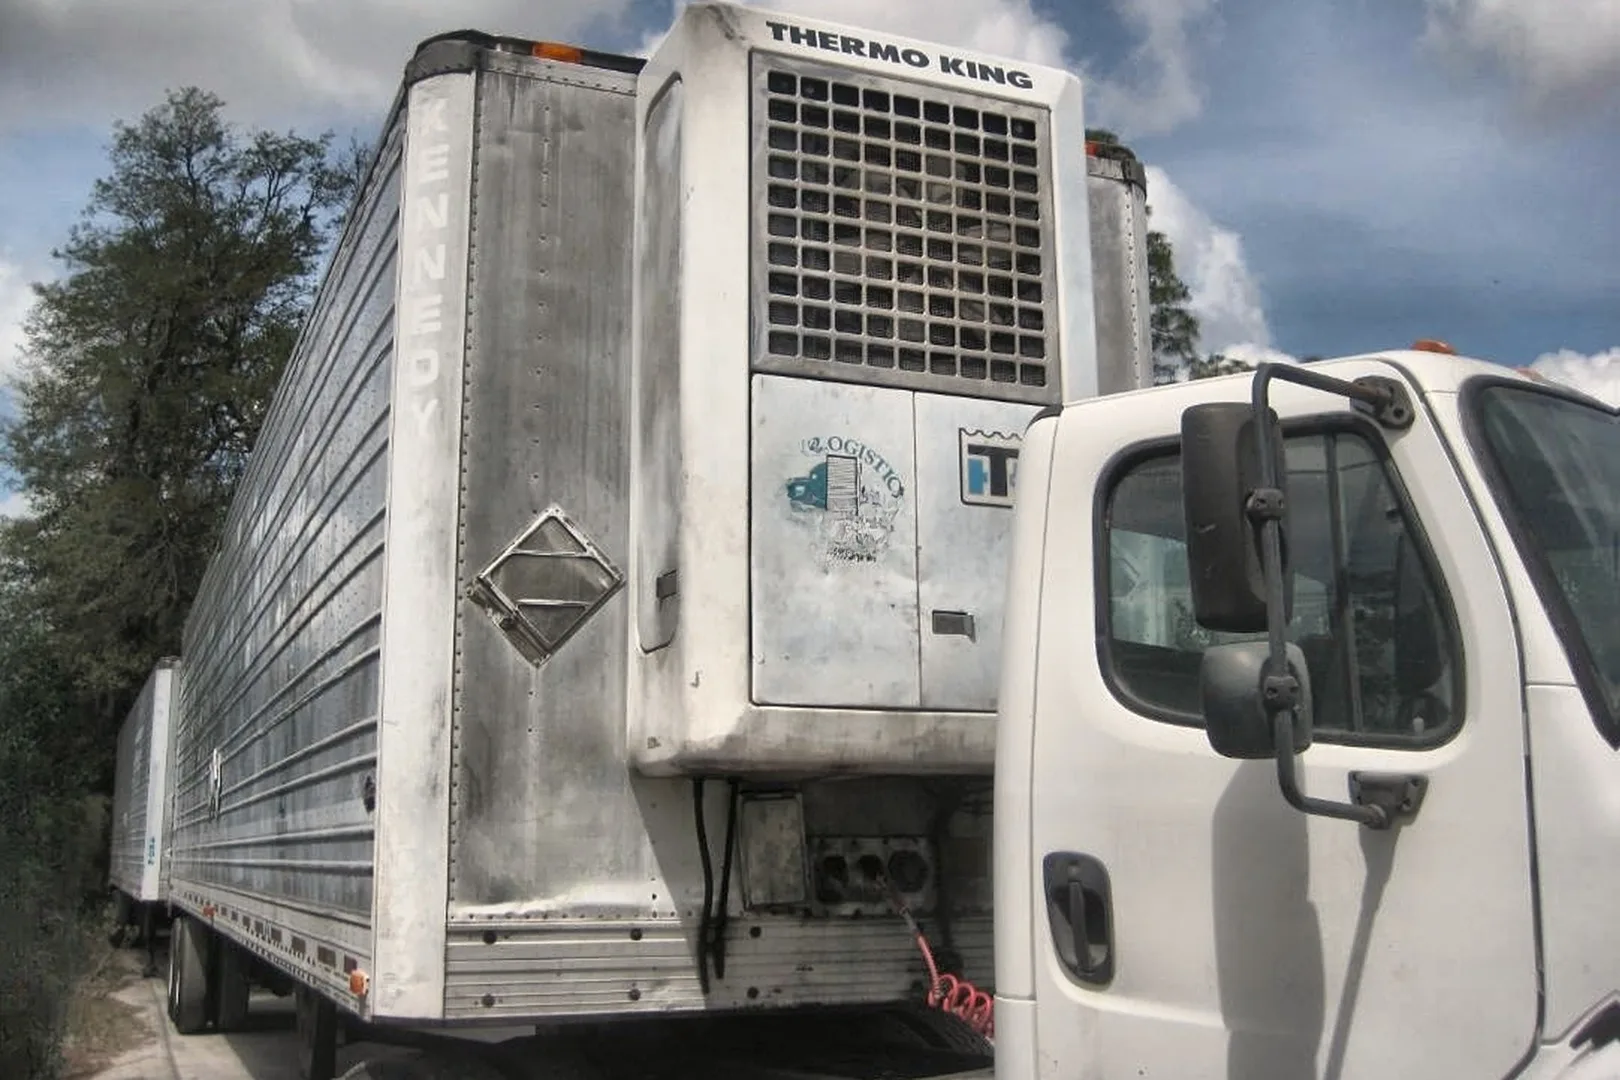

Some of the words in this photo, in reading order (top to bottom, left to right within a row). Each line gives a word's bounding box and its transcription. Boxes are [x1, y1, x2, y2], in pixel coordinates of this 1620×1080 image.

[766, 21, 930, 68] THERMO
[940, 55, 1033, 89] KING
[412, 97, 449, 437] KENNEDY
